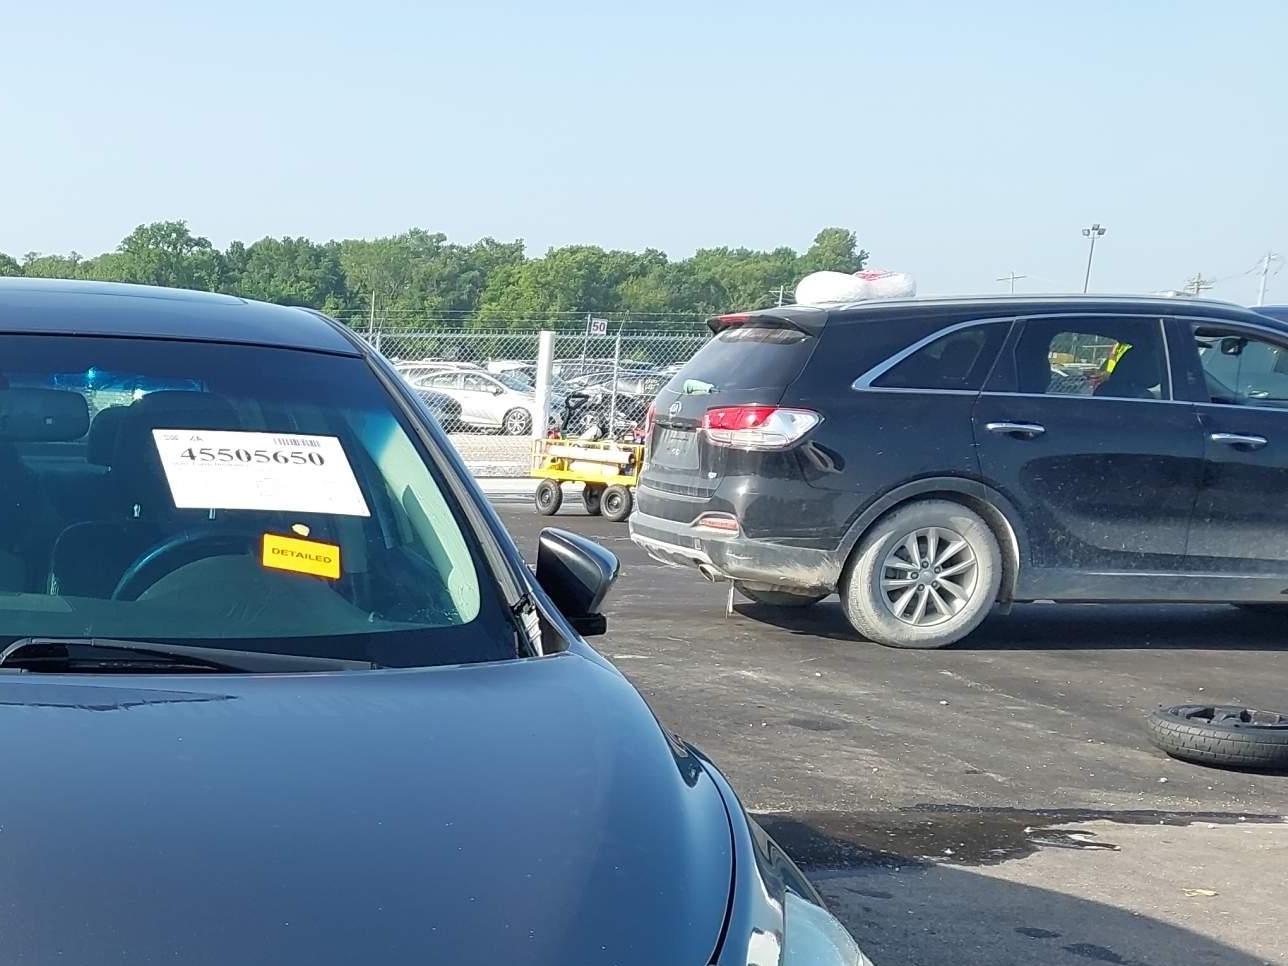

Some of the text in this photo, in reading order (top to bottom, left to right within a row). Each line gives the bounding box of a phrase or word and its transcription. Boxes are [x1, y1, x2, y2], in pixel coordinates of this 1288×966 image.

[592, 321, 606, 332] 50
[180, 447, 326, 467] 45505650
[271, 547, 332, 564] DETAILED
